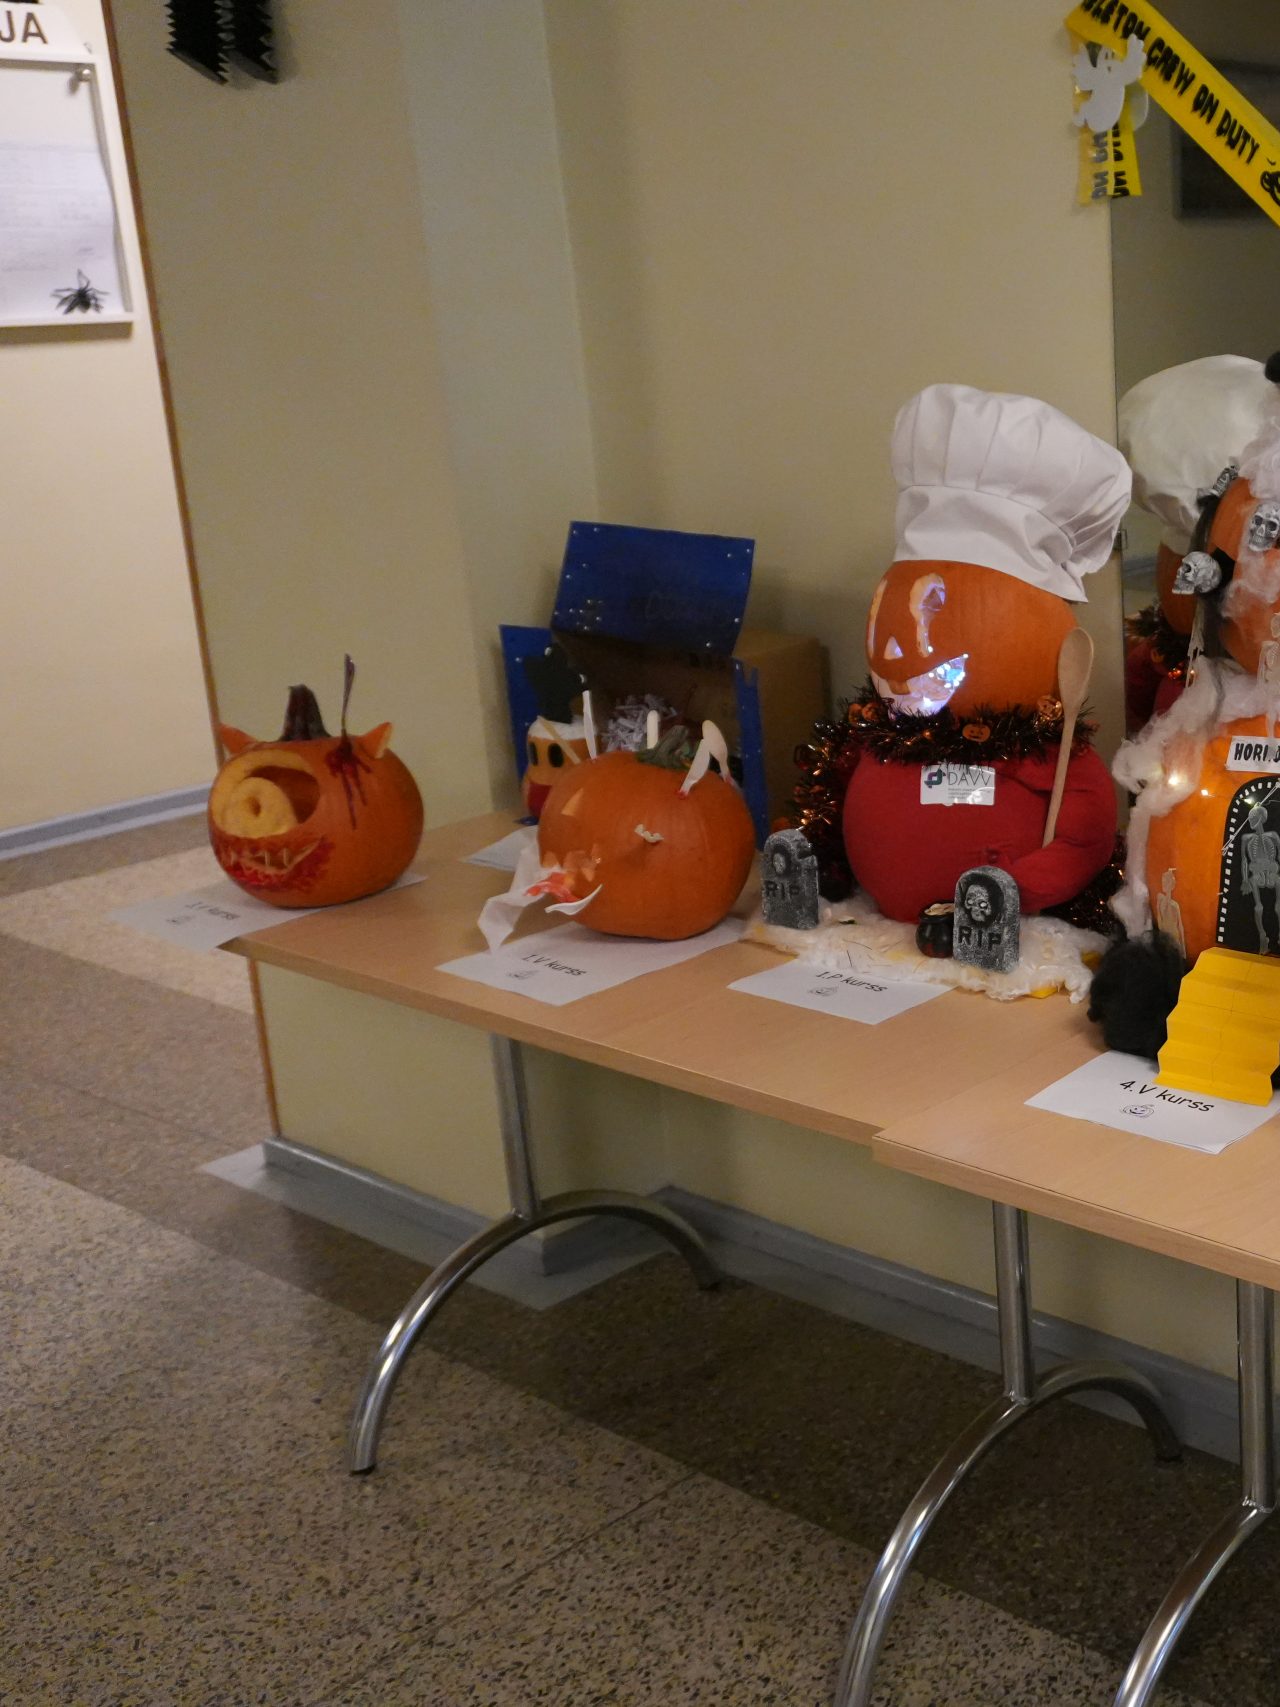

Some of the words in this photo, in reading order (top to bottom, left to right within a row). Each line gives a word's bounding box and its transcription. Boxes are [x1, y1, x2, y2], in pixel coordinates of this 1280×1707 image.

[1192, 84, 1220, 125] ON
[1215, 108, 1260, 165] DUTY
[765, 880, 801, 899] RIP
[957, 925, 1002, 950] RIP
[544, 960, 587, 976] kurss
[839, 976, 889, 993] kurss
[1120, 1080, 1158, 1095] 4.V
[1155, 1089, 1215, 1113] kurss
